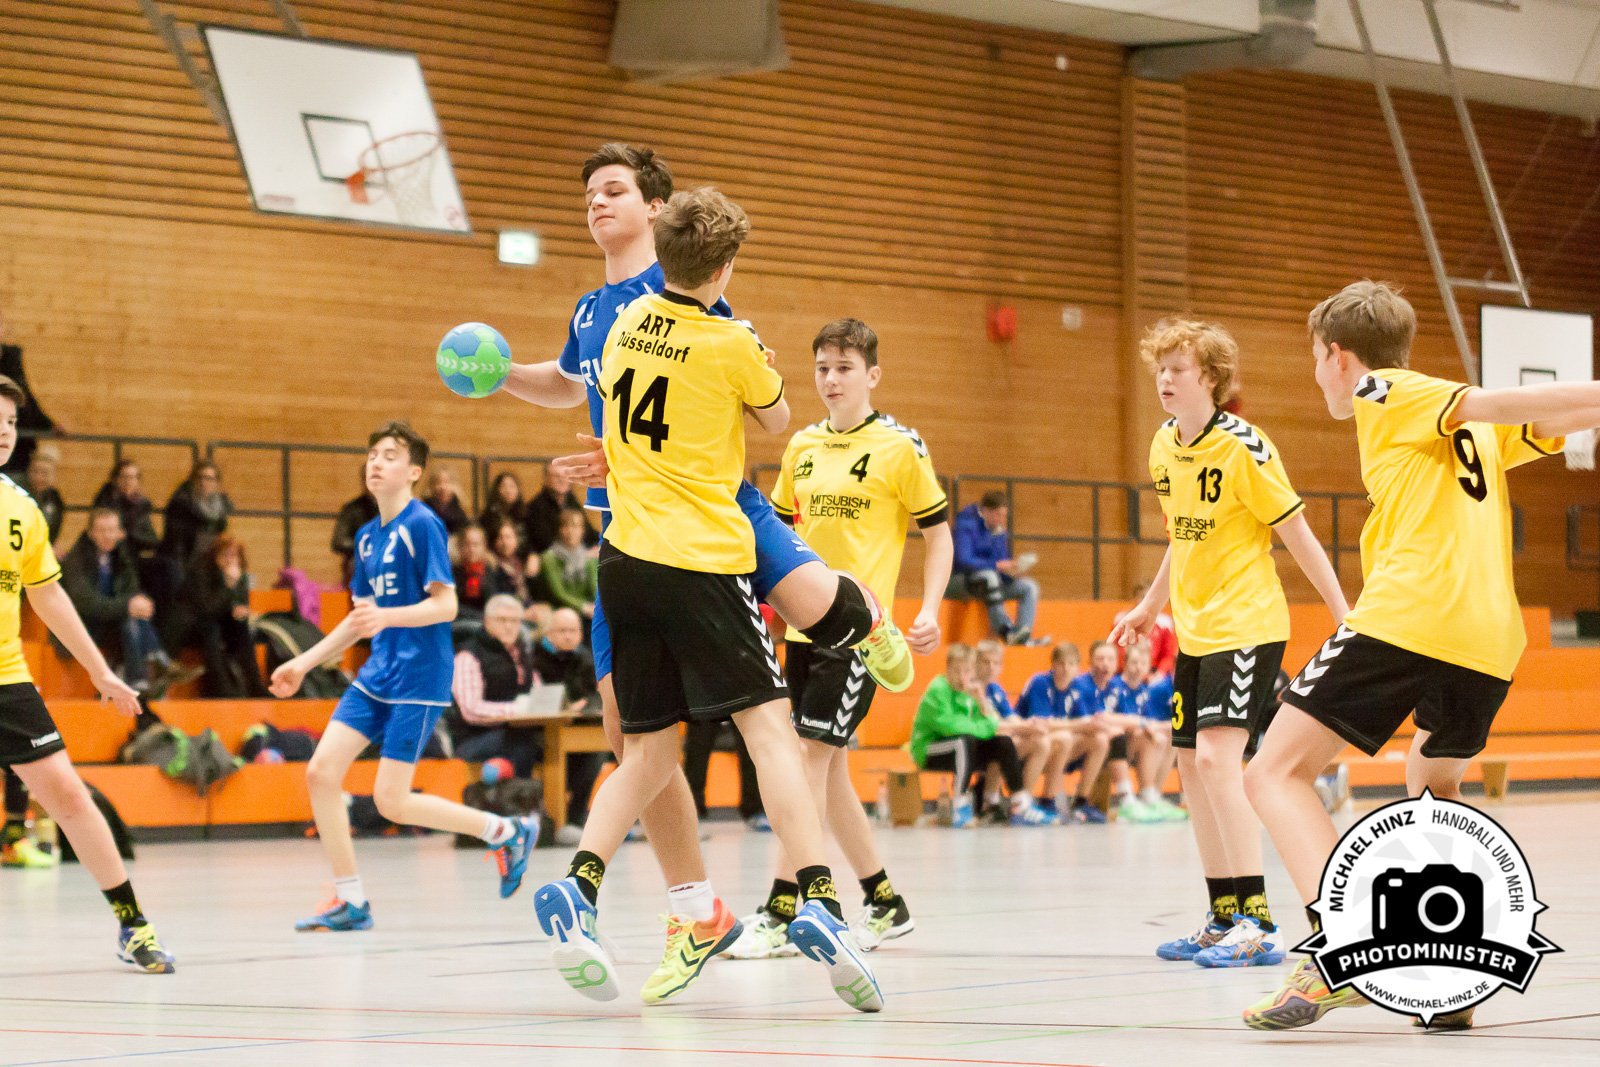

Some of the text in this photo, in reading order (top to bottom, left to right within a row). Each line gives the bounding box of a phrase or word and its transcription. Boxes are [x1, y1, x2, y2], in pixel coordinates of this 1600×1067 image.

[637, 313, 676, 338] ART
[617, 331, 691, 363] Düsseldorf
[612, 367, 670, 453] 14
[849, 453, 871, 483] 4
[1453, 428, 1487, 503] 9
[1197, 467, 1223, 503] 13
[809, 506, 861, 519] ELECTRIC
[810, 494, 871, 509] MITSUBISHI
[9, 519, 23, 551] 5
[383, 531, 398, 563] 2
[801, 715, 831, 730] hummel
[1172, 692, 1184, 730] 3
